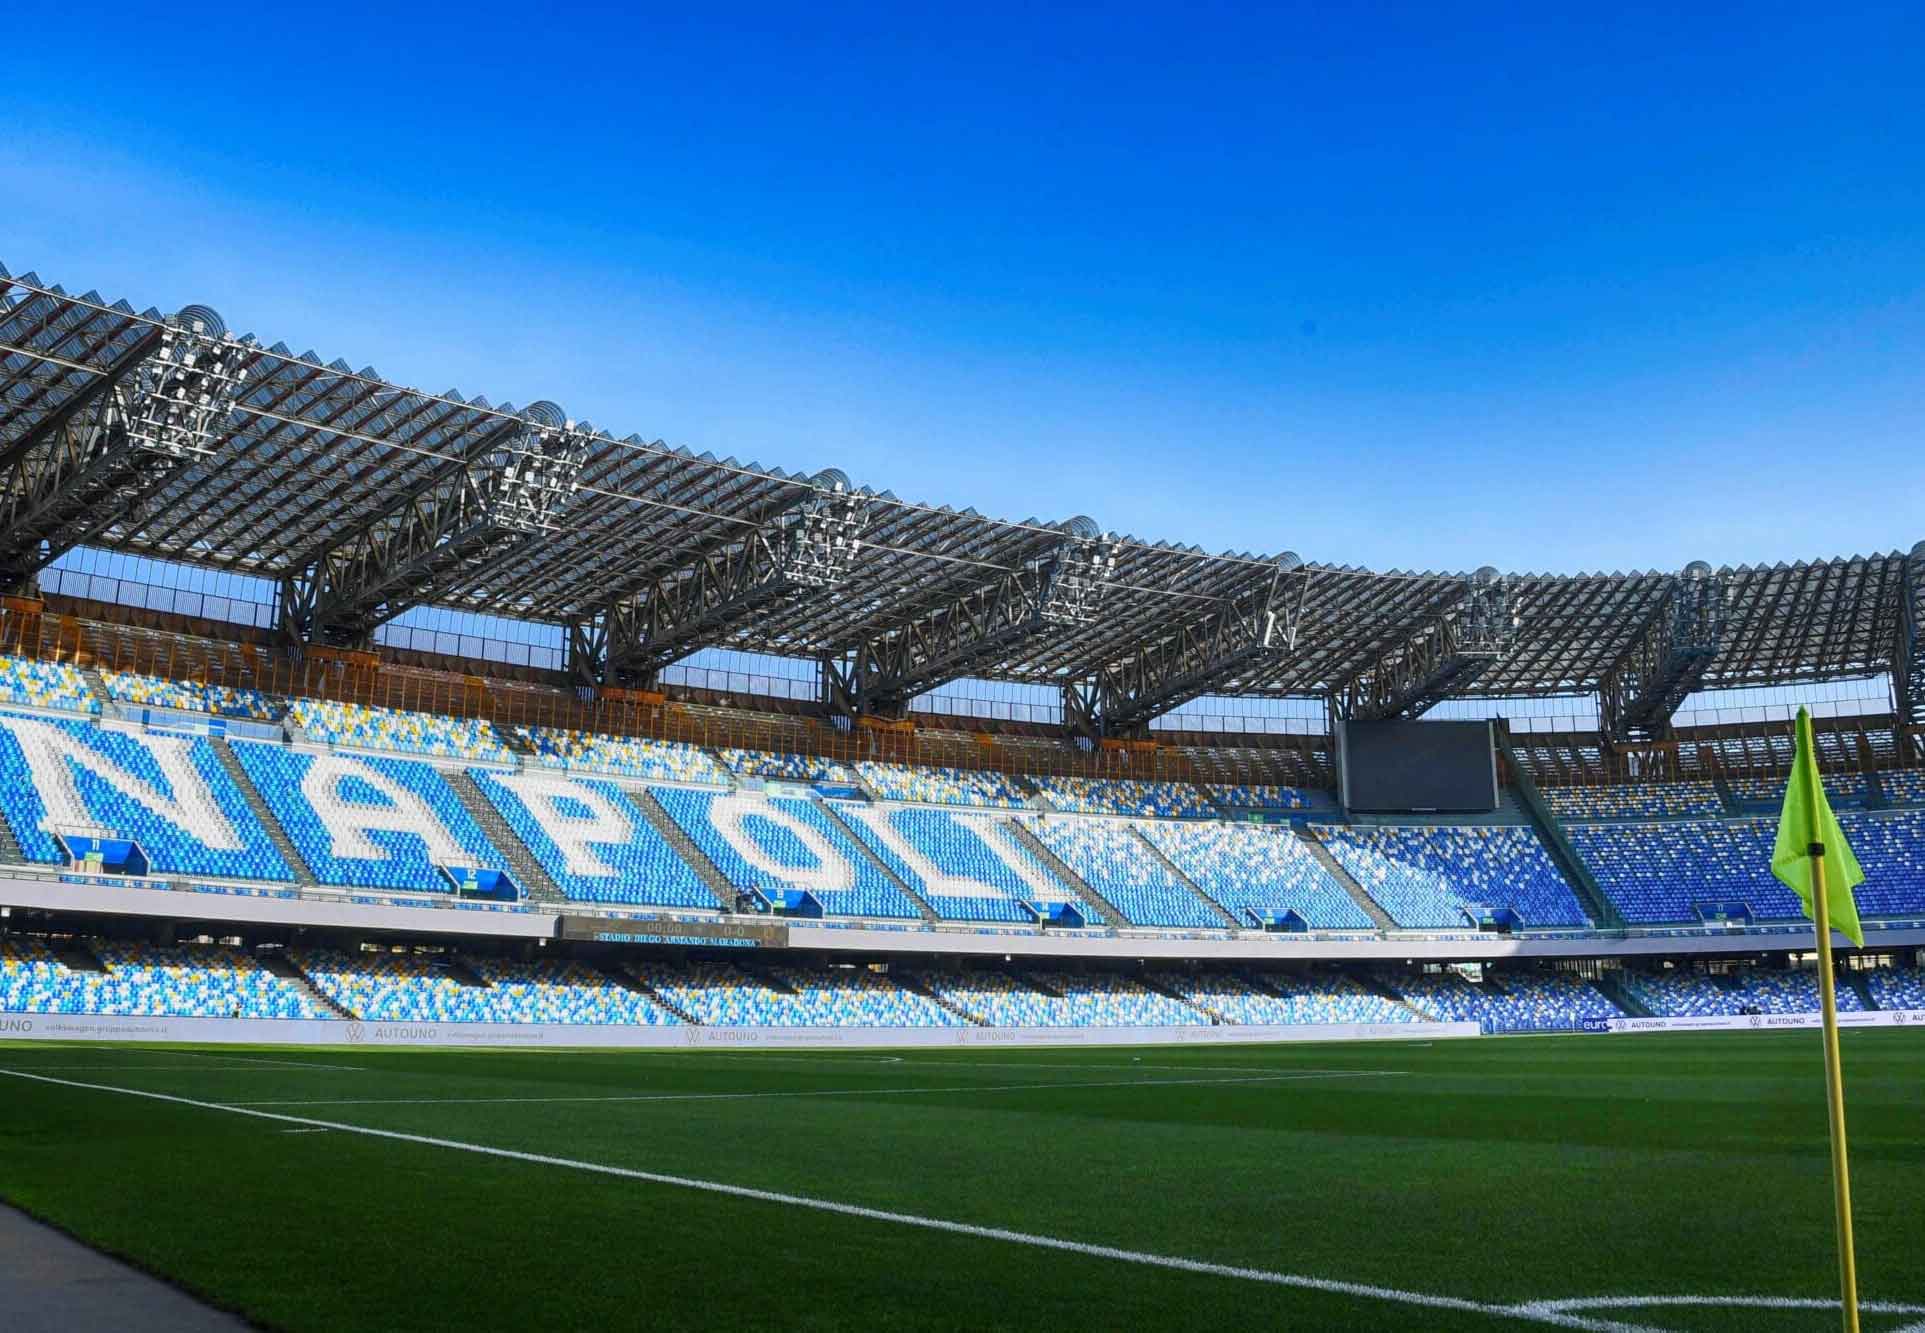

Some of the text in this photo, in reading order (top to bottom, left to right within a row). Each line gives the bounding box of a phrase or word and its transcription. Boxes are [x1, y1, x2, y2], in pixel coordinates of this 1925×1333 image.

[4, 716, 1084, 900] NAPOLI
[634, 934, 662, 944] DIEGO
[375, 1027, 437, 1040] AUTOUNO
[708, 1031, 758, 1041] AUTOUNO
